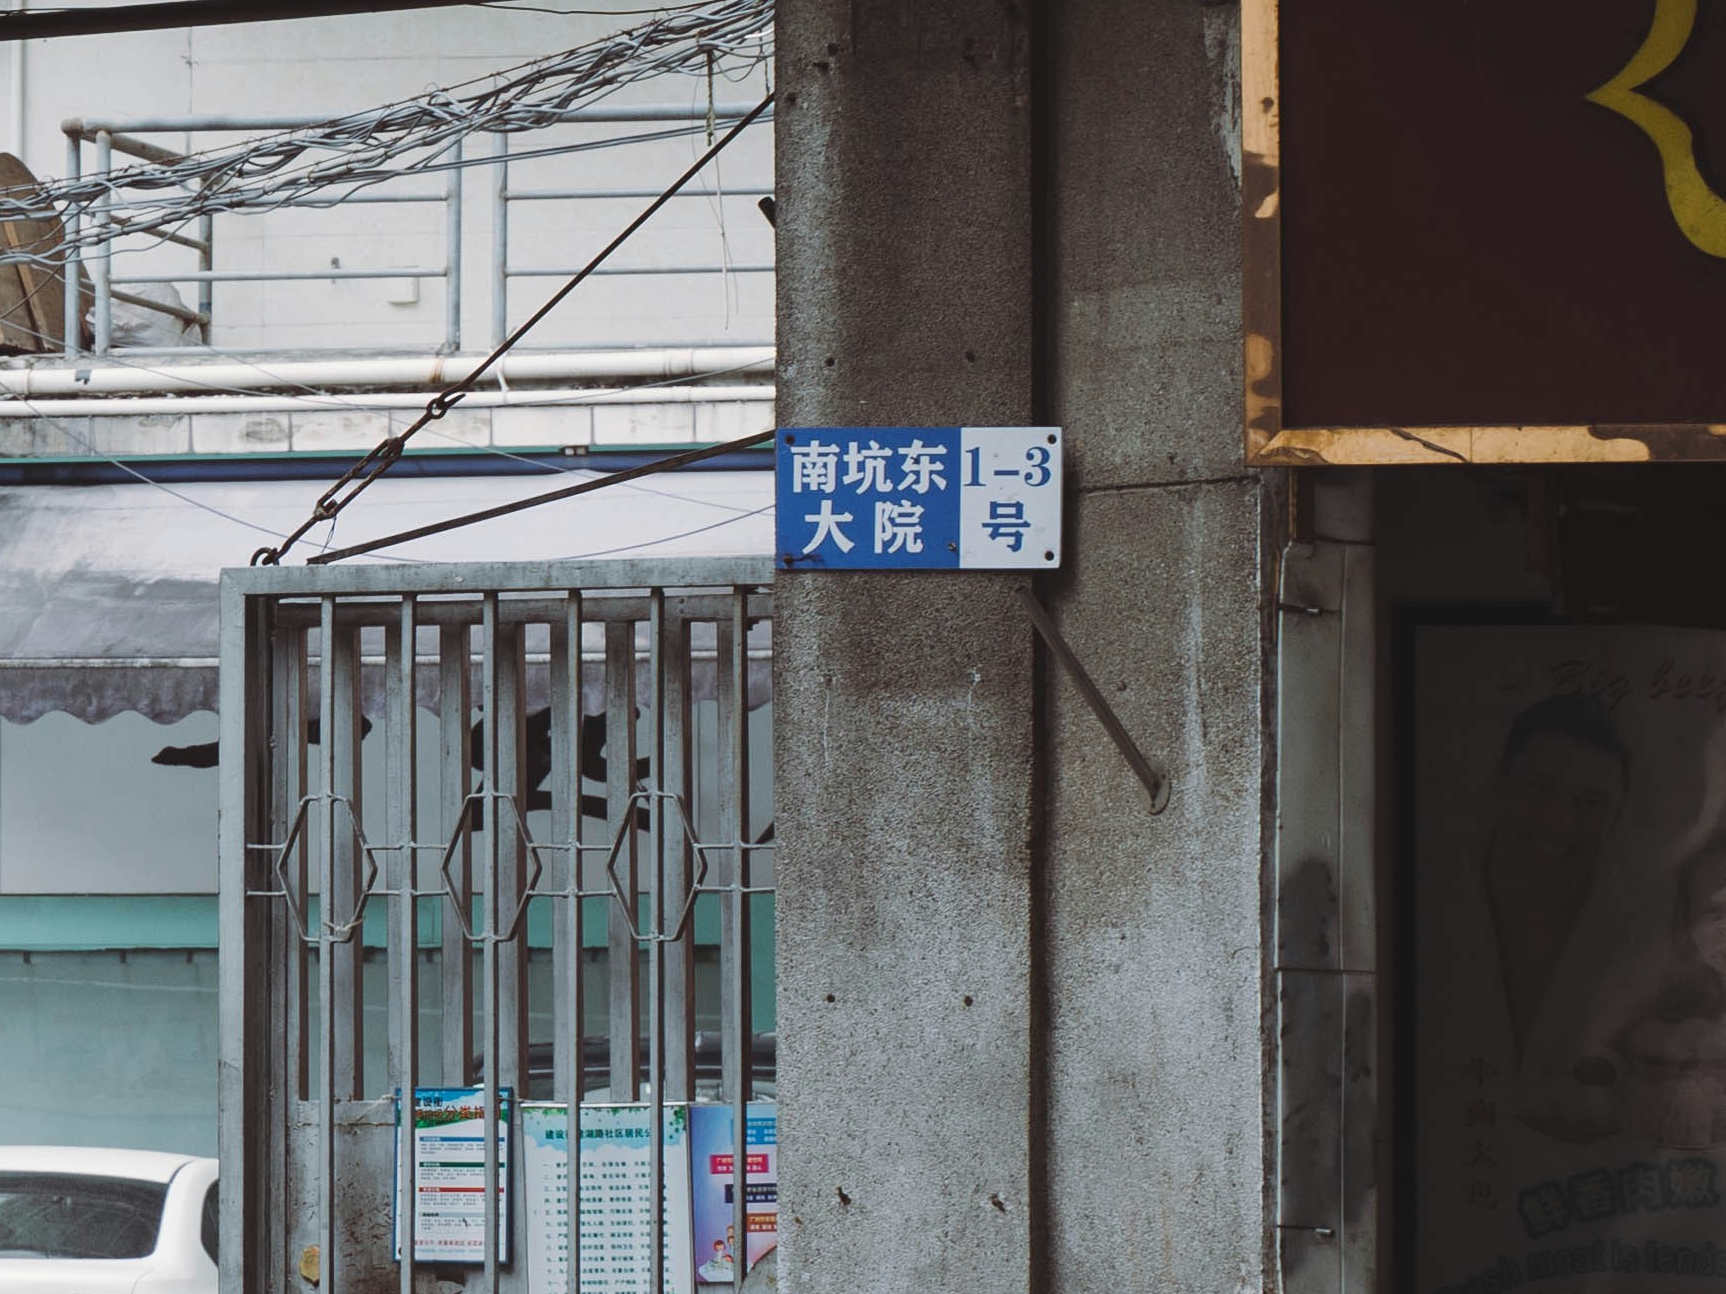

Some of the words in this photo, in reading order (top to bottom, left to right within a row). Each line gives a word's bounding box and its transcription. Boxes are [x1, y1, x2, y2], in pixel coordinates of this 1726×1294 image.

[791, 439, 948, 494] 南坑东
[963, 446, 1052, 487] 1-3
[802, 500, 925, 554] 大院
[981, 501, 1031, 552] 号
